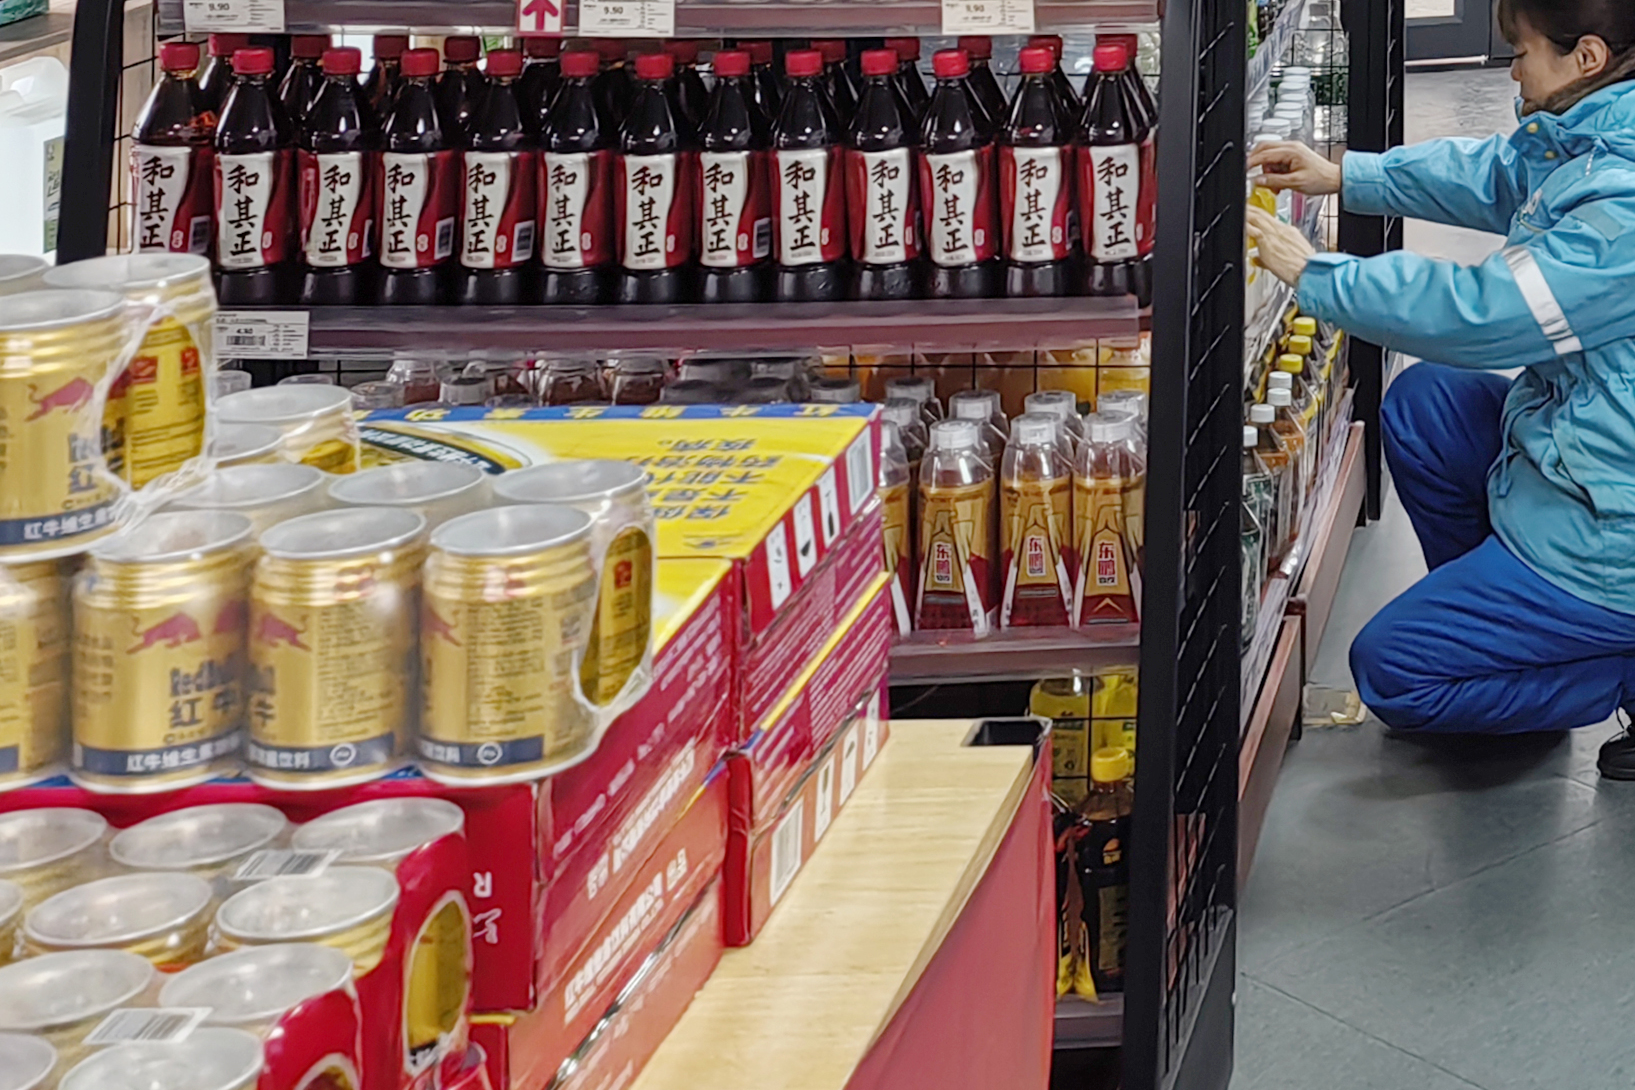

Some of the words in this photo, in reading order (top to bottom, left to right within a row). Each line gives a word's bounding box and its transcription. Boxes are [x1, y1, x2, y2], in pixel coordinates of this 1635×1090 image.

[140, 156, 174, 248] 和其正
[227, 164, 260, 255] 和其正
[321, 164, 352, 253] 和其正
[386, 163, 415, 253] 和其正
[467, 162, 497, 253] 和其正
[550, 164, 578, 253] 和其正
[632, 164, 663, 257] 和其正
[705, 162, 735, 252] 和其正
[785, 160, 816, 250] 和其正
[871, 158, 900, 249] 和其正
[936, 164, 969, 254] 和其正
[1020, 157, 1048, 248] 和其正
[1097, 155, 1130, 248] 和其正
